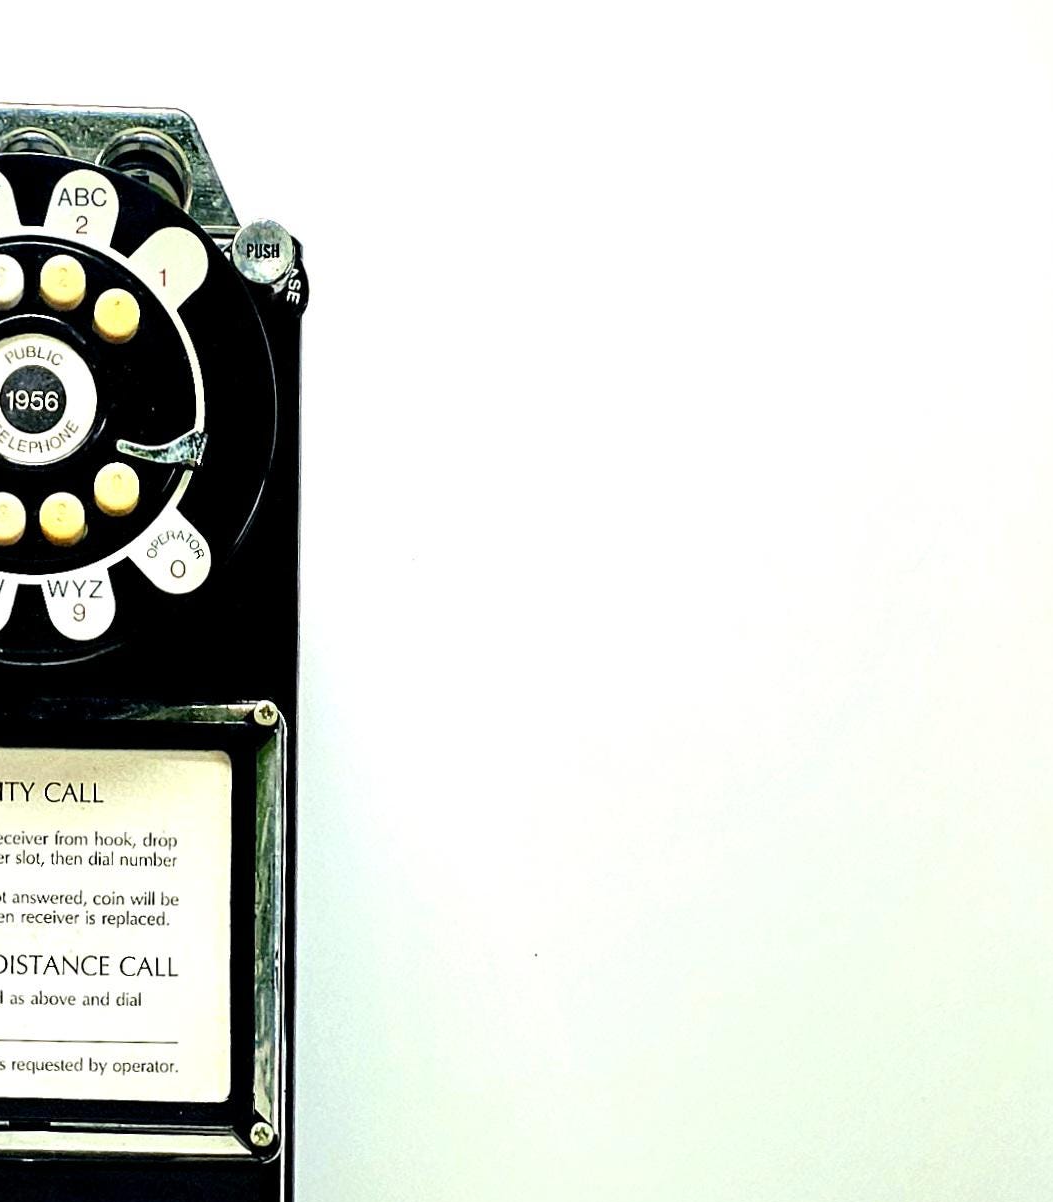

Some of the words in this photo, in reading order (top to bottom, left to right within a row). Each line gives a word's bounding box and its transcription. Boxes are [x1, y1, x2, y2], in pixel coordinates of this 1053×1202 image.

[58, 188, 106, 206] ABC
[76, 216, 88, 234] 2
[246, 243, 280, 259] PUSH
[158, 269, 166, 287] 1
[4, 344, 64, 368] PUBLIC
[5, 389, 60, 413] 1956
[146, 530, 204, 560] OPERATOR
[171, 560, 185, 578] 0
[47, 580, 102, 598] WYZ
[73, 604, 85, 622] 9
[45, 782, 103, 802] CALL
[55, 831, 87, 845] from
[95, 831, 136, 848] hook,
[143, 832, 177, 850] drop
[16, 850, 44, 867] slot,
[51, 851, 82, 865] then
[89, 851, 113, 866] dial
[120, 852, 176, 867] number
[13, 891, 87, 906] answered,
[93, 892, 124, 905] coin
[131, 891, 155, 905] will
[161, 892, 179, 906] be
[22, 911, 79, 924] receiver
[86, 911, 95, 924] is
[102, 911, 169, 928] replaced.
[120, 956, 178, 977] CALL
[10, 995, 24, 1004] as
[31, 991, 76, 1005] above
[83, 992, 109, 1006] and
[116, 992, 141, 1006] dial
[12, 1058, 83, 1074] requested
[89, 1058, 107, 1075] by
[113, 1061, 178, 1075] operator.
